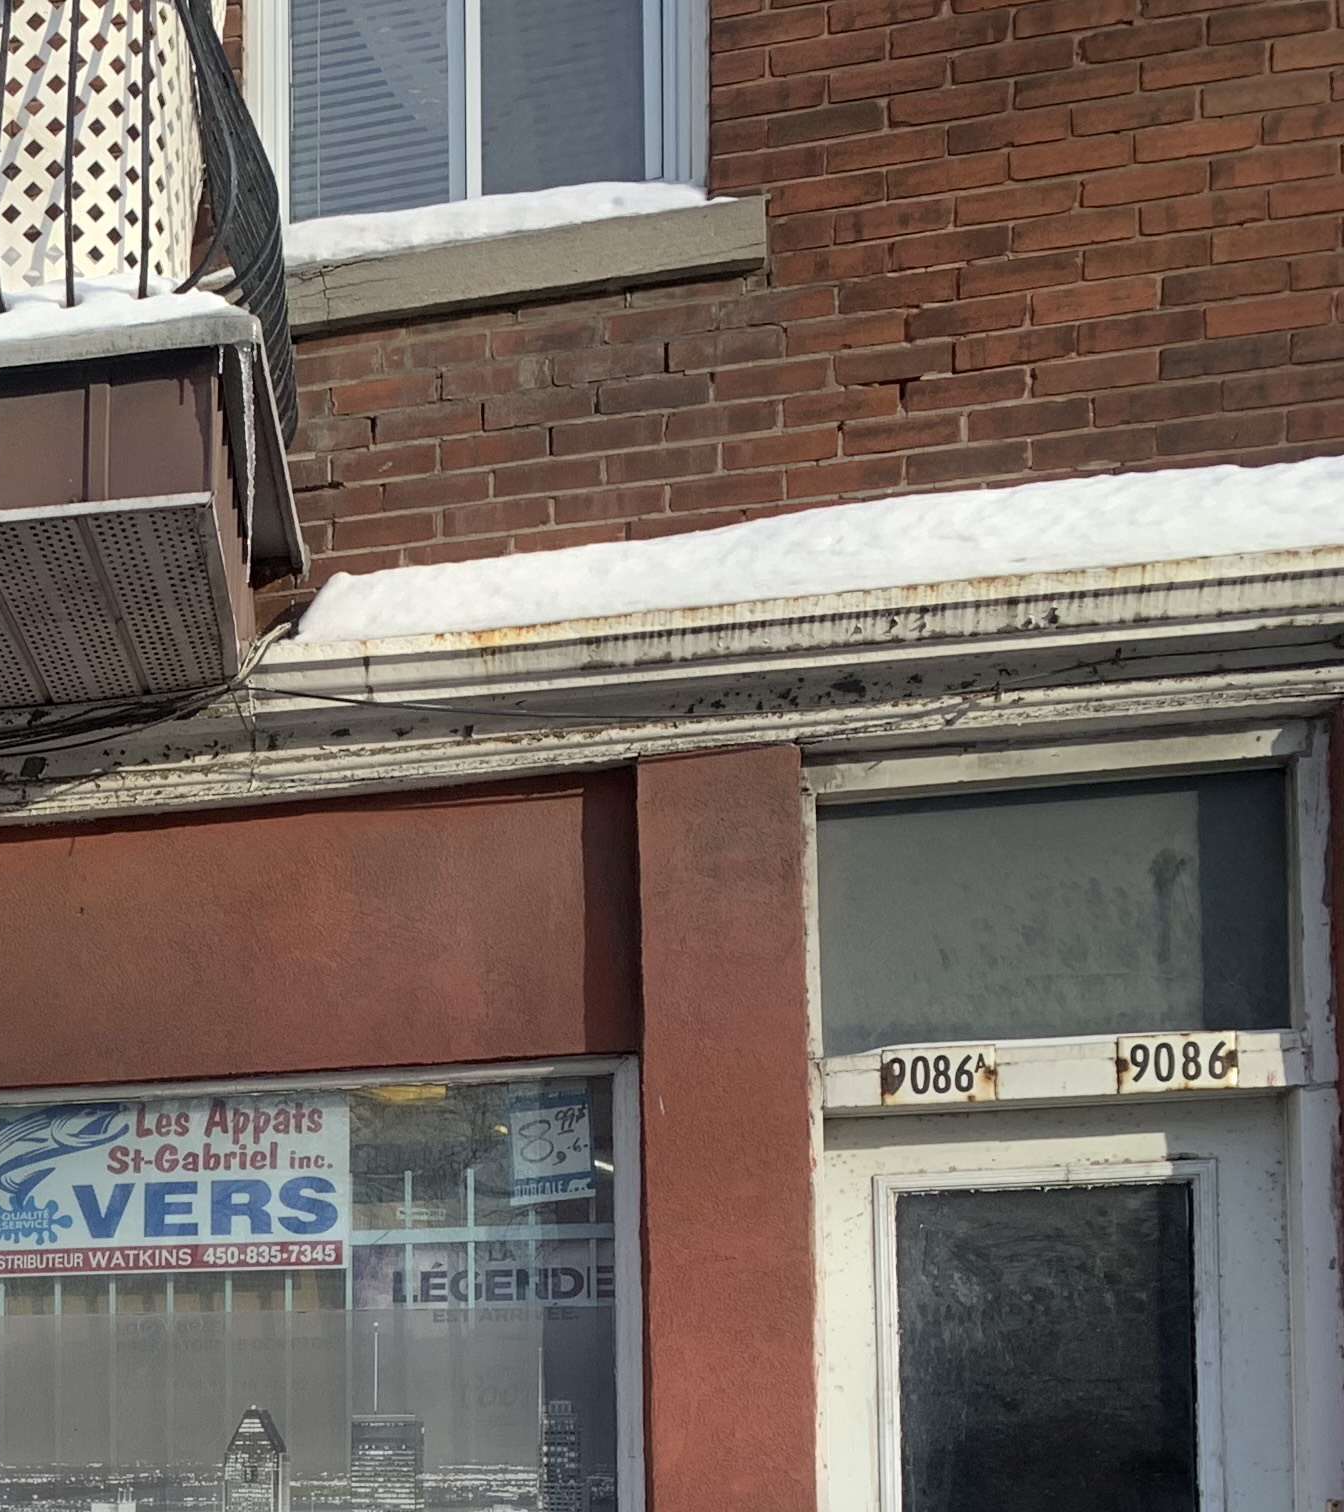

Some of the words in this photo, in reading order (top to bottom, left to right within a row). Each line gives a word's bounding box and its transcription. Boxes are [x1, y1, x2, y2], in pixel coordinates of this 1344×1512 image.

[1130, 1040, 1228, 1083] 9086
[135, 1102, 191, 1139] Les
[203, 1098, 323, 1145] Appâts
[107, 1142, 278, 1175] St-Gabriel
[289, 1150, 334, 1170] inc.
[1, 1219, 50, 1230] SERVICE
[2, 1208, 50, 1221] QUALITÉ
[71, 1176, 339, 1240] VERS
[88, 1247, 192, 1269] WATKINS
[202, 1244, 337, 1265] 450-835-7345
[392, 1261, 616, 1304] LÉGENDE
